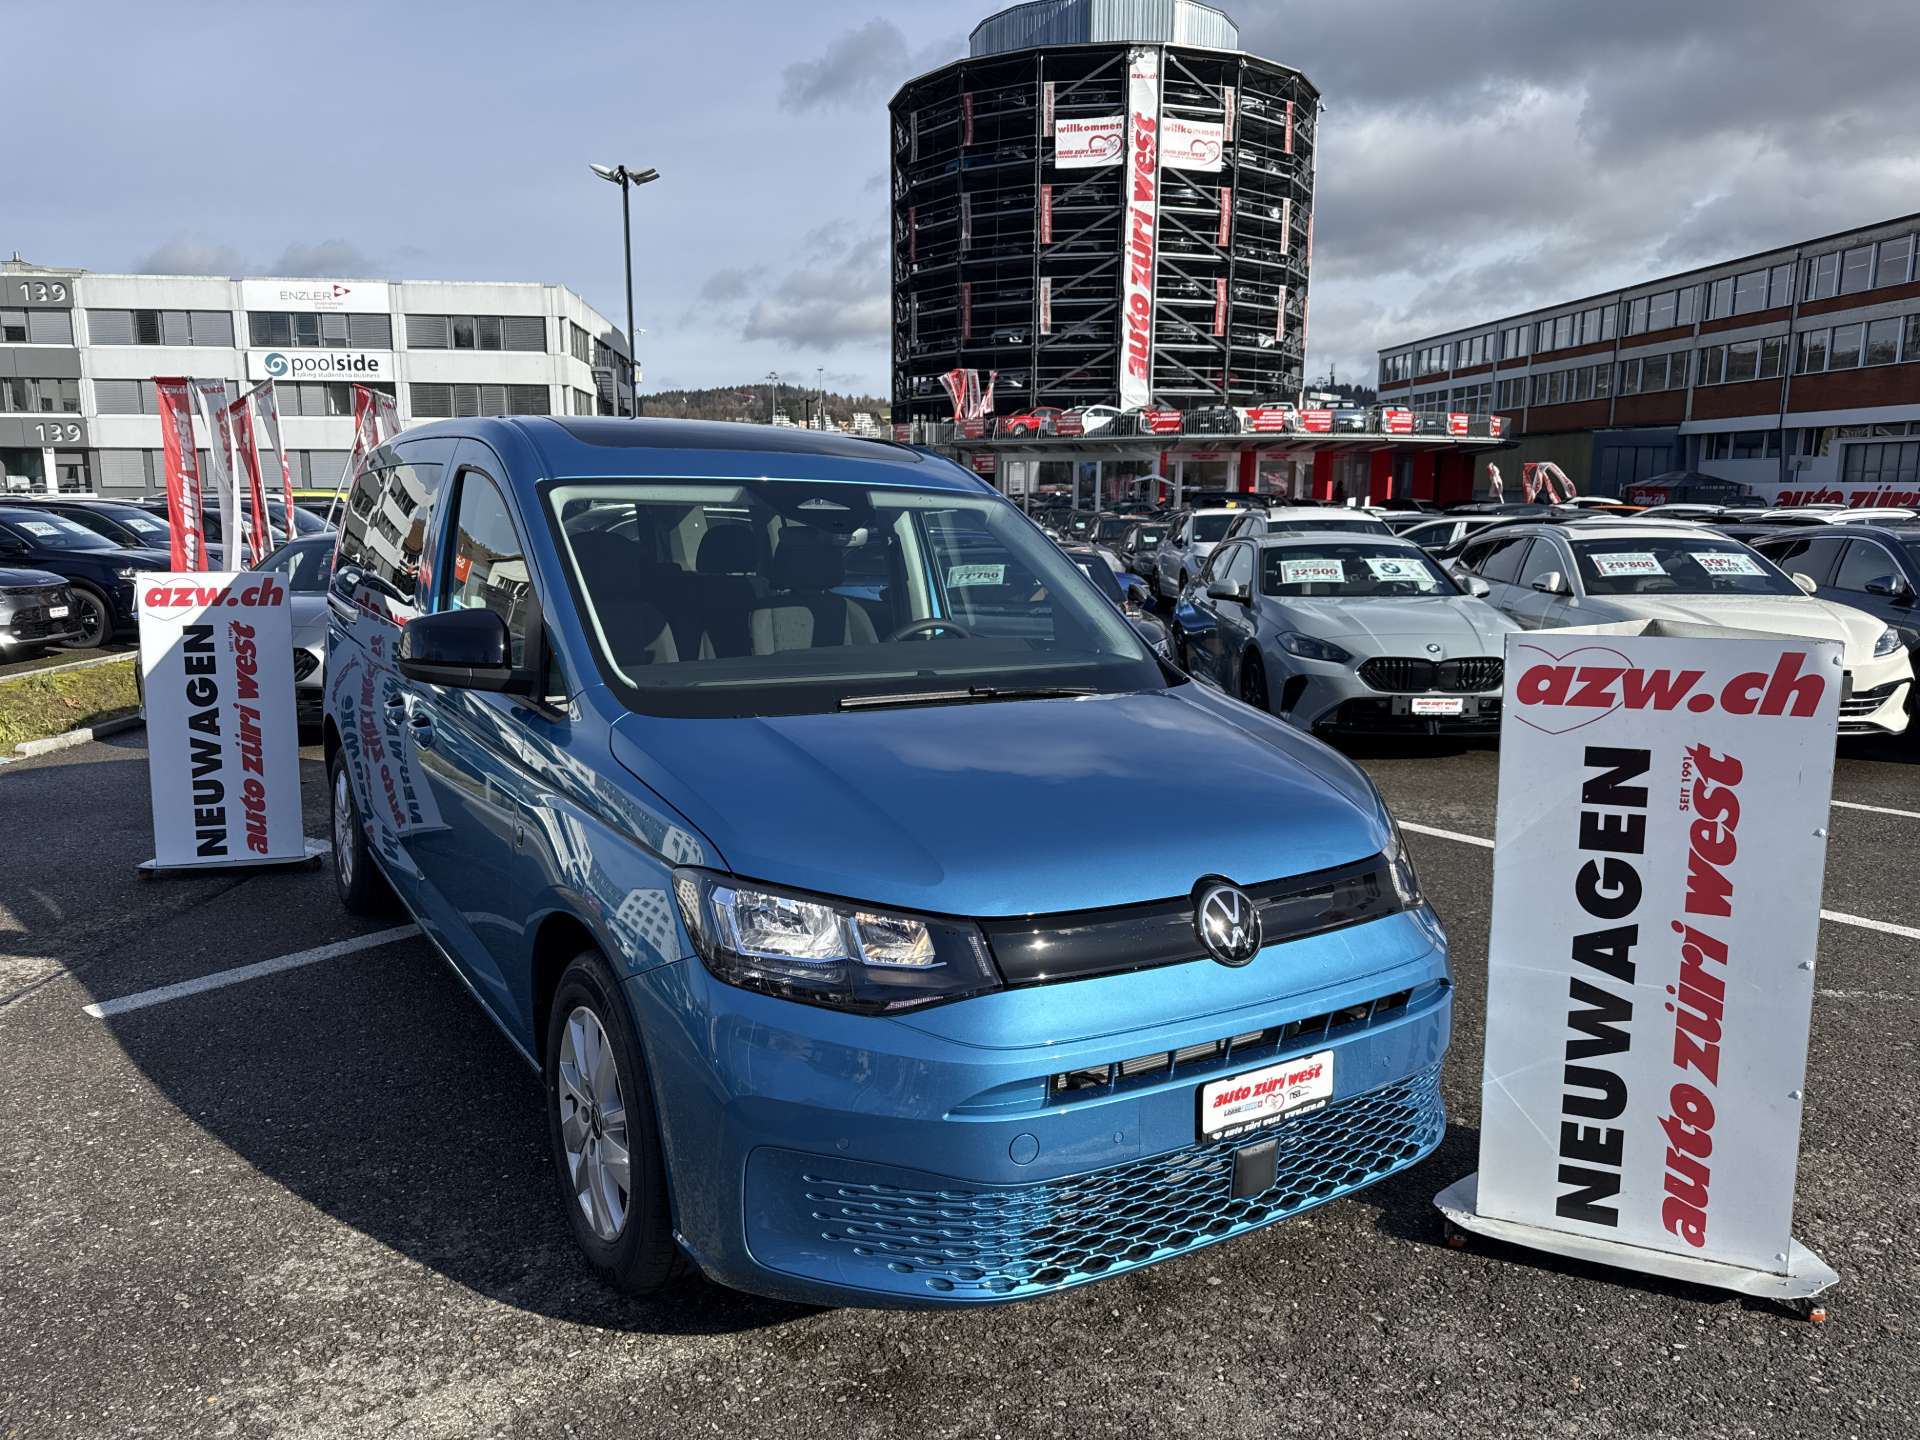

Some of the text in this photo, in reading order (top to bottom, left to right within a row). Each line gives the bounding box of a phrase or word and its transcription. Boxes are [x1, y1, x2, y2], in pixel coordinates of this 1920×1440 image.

[1057, 122, 1123, 134] willkommen
[1126, 111, 1157, 382] auto züri west
[19, 282, 67, 302] 139
[280, 291, 332, 301] ENZLER
[291, 353, 379, 377] poolside
[35, 423, 82, 442] 139
[1774, 486, 1844, 506] auto
[1291, 568, 1338, 576] 32'500
[1606, 561, 1655, 569] 29'800
[144, 577, 284, 607] azw.ch
[1516, 652, 1826, 718] azw.ch
[182, 624, 228, 857] NEUWAGEN
[228, 619, 269, 854] auto züri west
[1679, 756, 1693, 811] SEIT 1991
[1556, 745, 1652, 1228] NEUWAGEN
[1657, 743, 1744, 1248] auto züri west
[1213, 1064, 1323, 1107] auto züri west
